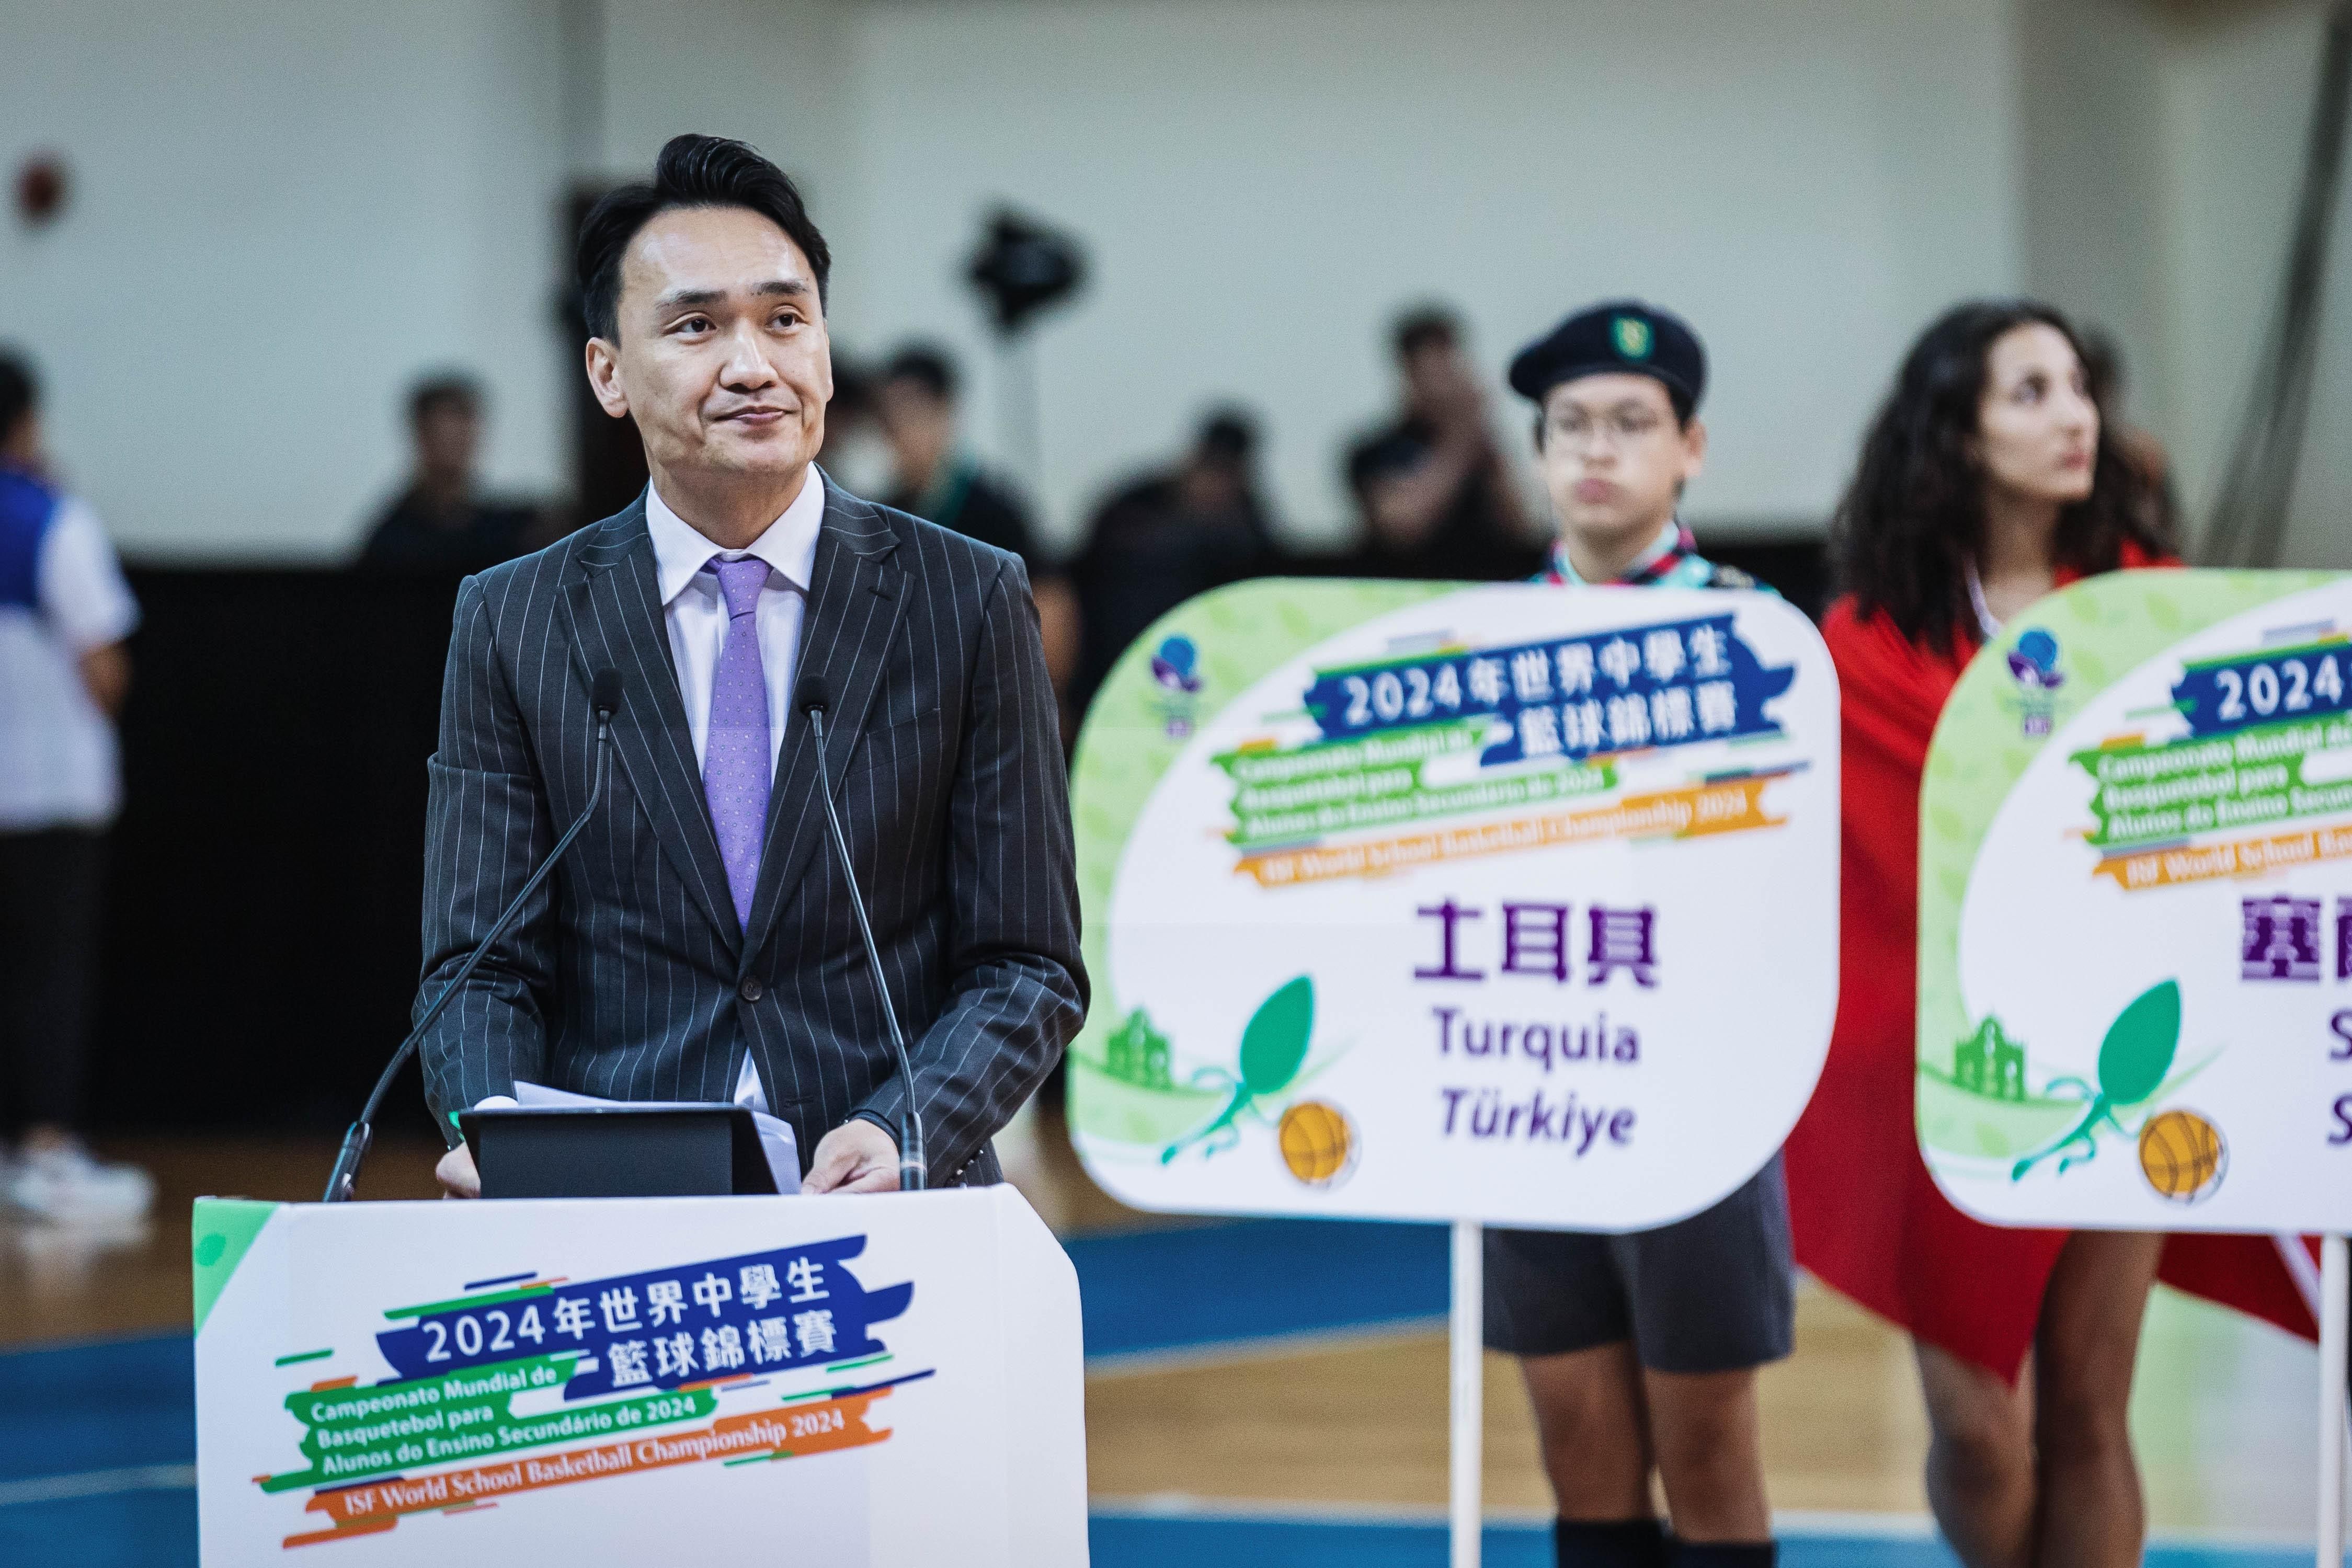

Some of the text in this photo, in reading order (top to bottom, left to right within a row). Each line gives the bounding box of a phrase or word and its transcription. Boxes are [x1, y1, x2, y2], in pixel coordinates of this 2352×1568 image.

[2241, 892, 2352, 983] 塞
[1432, 1006, 1641, 1073] Turquia
[1441, 1086, 1638, 1159] Türkiye
[422, 1256, 830, 1362] 2024年世界中學生
[607, 1310, 838, 1387] 籃球錦標賽
[311, 1365, 556, 1423] Campeonato Mundial de
[317, 1405, 494, 1449] Basquetebol para
[323, 1395, 696, 1476] Alunos do Ensino Secundário de 2024
[344, 1407, 846, 1515] ISF World School Basketball Championship 2024
